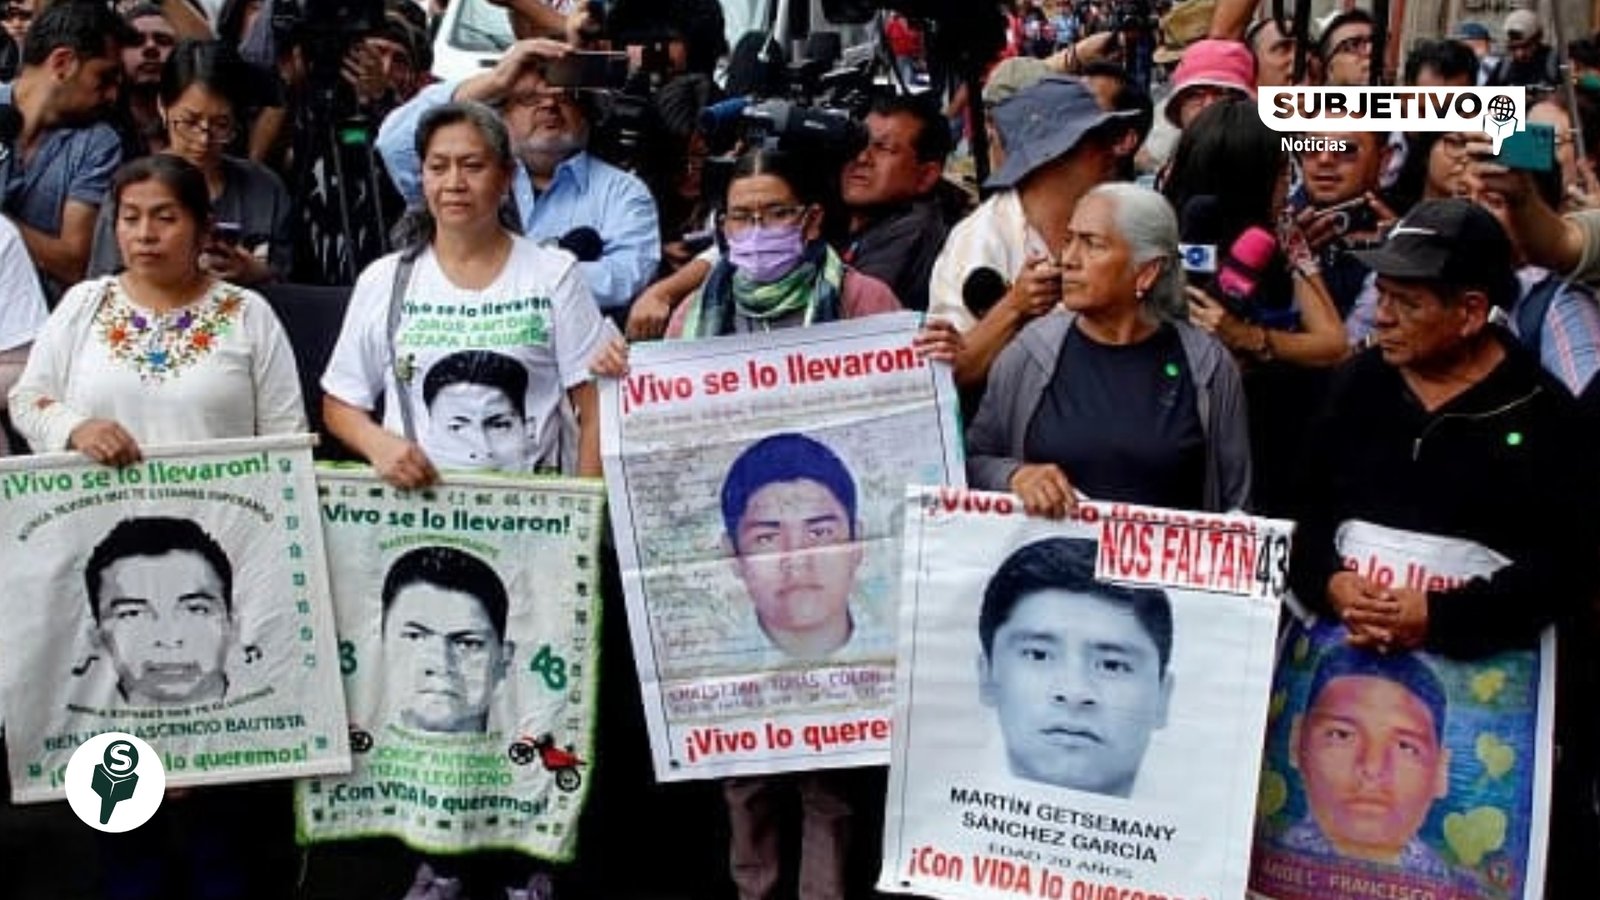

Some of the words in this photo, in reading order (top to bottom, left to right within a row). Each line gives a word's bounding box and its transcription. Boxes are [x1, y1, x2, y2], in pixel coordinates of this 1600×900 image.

[622, 373, 693, 414] ¡Vivo
[703, 370, 740, 395] se
[748, 361, 778, 389] lo
[3, 471, 73, 500] ¡Vivo
[82, 470, 111, 490] se
[117, 463, 142, 486] lo
[148, 453, 270, 485] llevaron!
[388, 510, 416, 527] se
[422, 508, 446, 530] lo
[453, 511, 570, 534] llevaron!
[1101, 516, 1153, 577] NOS
[1161, 524, 1256, 589] FALTAN
[1256, 534, 1289, 597] 43
[1369, 554, 1394, 588] lo
[531, 645, 568, 690] 43
[165, 752, 187, 771] lo
[193, 743, 307, 768] queremos!
[686, 729, 757, 763] ¡Vivo
[766, 723, 793, 749] lo
[803, 718, 894, 752] quere
[329, 783, 373, 806] ¡Con
[442, 794, 547, 815] queremos!
[950, 787, 1030, 816] MARTÍN
[1037, 804, 1176, 841] GETSEMANY
[961, 810, 1065, 847] SÁNCHEZ
[1071, 833, 1157, 863] GARCÍA
[910, 848, 964, 882] ¡Con
[973, 856, 1031, 893] VIDA
[1040, 868, 1063, 900] lo
